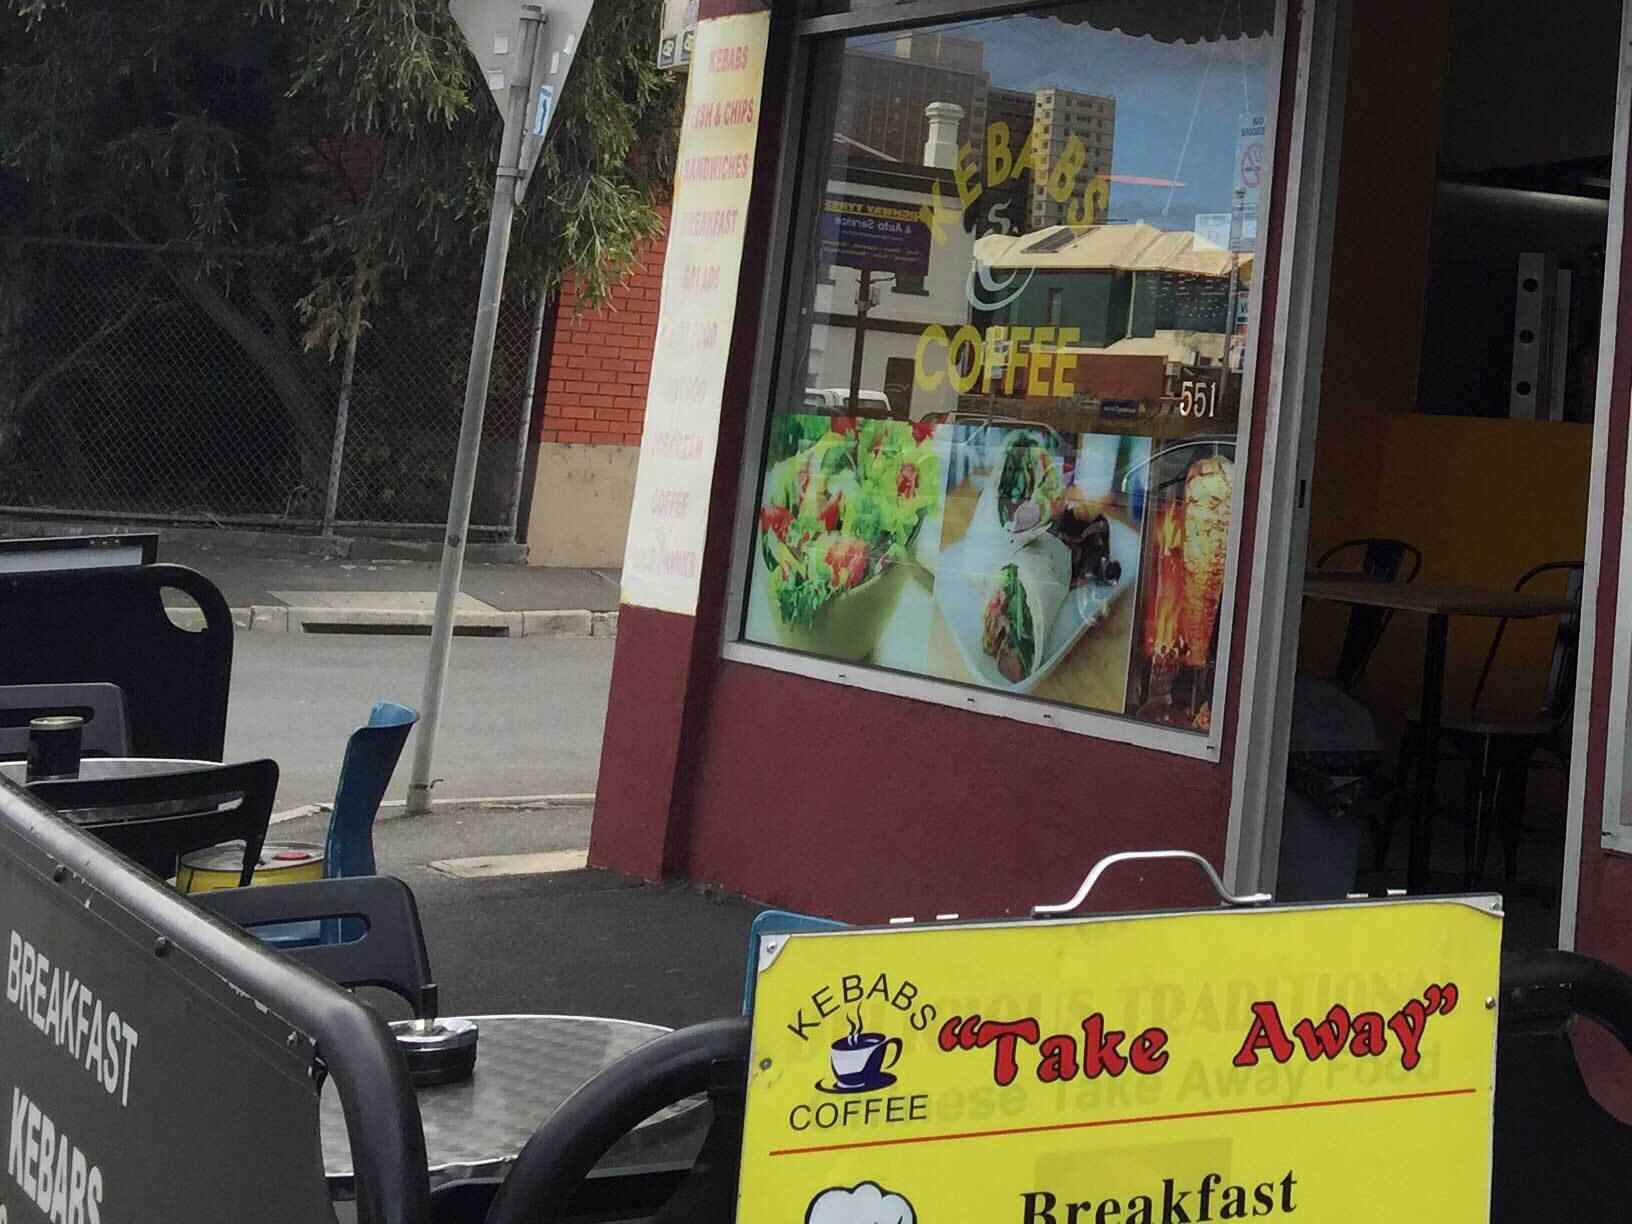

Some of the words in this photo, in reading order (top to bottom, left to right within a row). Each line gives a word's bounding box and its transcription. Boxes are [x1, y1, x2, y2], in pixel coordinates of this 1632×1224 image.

[709, 45, 750, 73] KEBABS
[723, 98, 754, 126] CHIPS
[919, 121, 1109, 246] KEBABS
[915, 324, 1081, 397] COFFEE
[1179, 381, 1216, 417] 551
[6, 929, 138, 1107] BREAKFAST
[788, 973, 936, 1041] KEBABS
[789, 1094, 929, 1132] COFFEE
[8, 1086, 103, 1224] KEBABS
[1020, 1169, 1298, 1224] Breakfast
